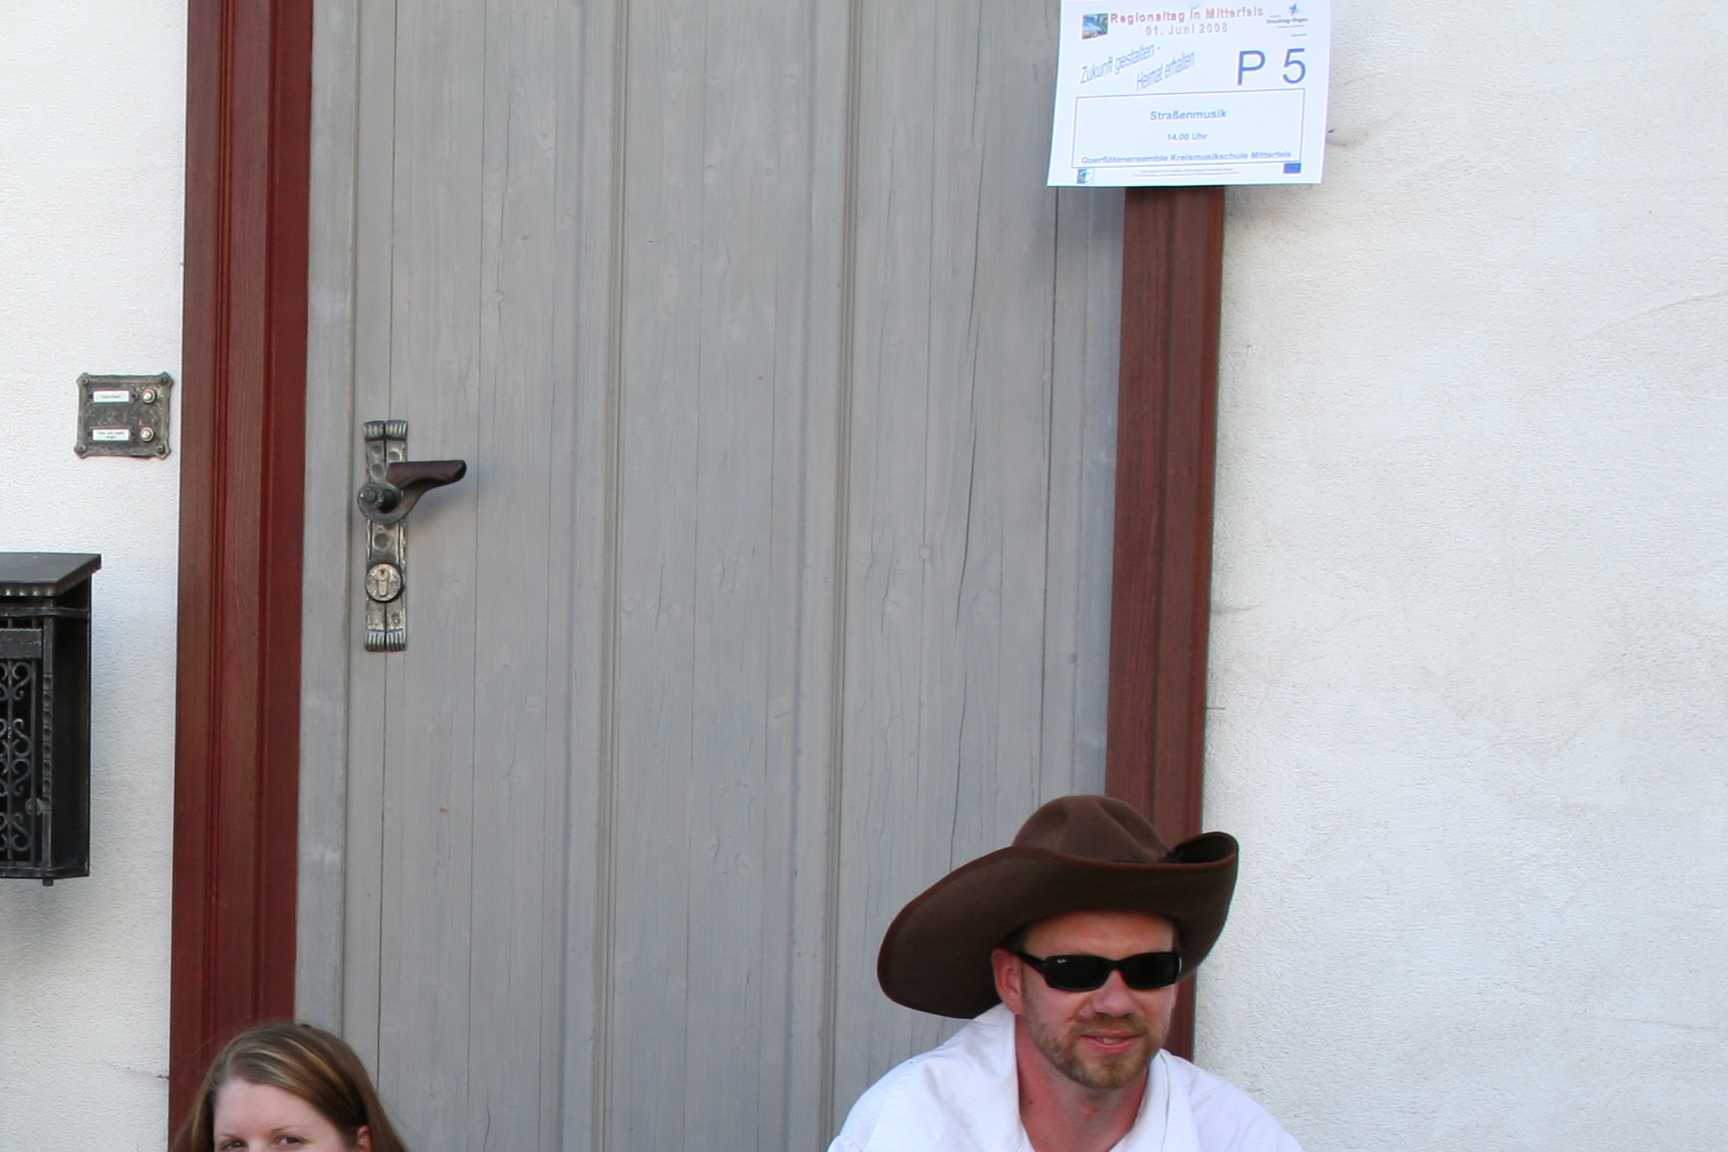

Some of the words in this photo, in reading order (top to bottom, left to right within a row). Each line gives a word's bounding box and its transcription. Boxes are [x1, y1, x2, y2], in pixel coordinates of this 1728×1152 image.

[1111, 11, 1185, 25] Regionaltag
[1190, 8, 1201, 20] in
[1206, 6, 1265, 19] Mitterfels
[1168, 23, 1196, 35] Juni
[1237, 50, 1266, 86] P
[1282, 47, 1307, 84] 5
[1150, 109, 1227, 120] Straßenmusik
